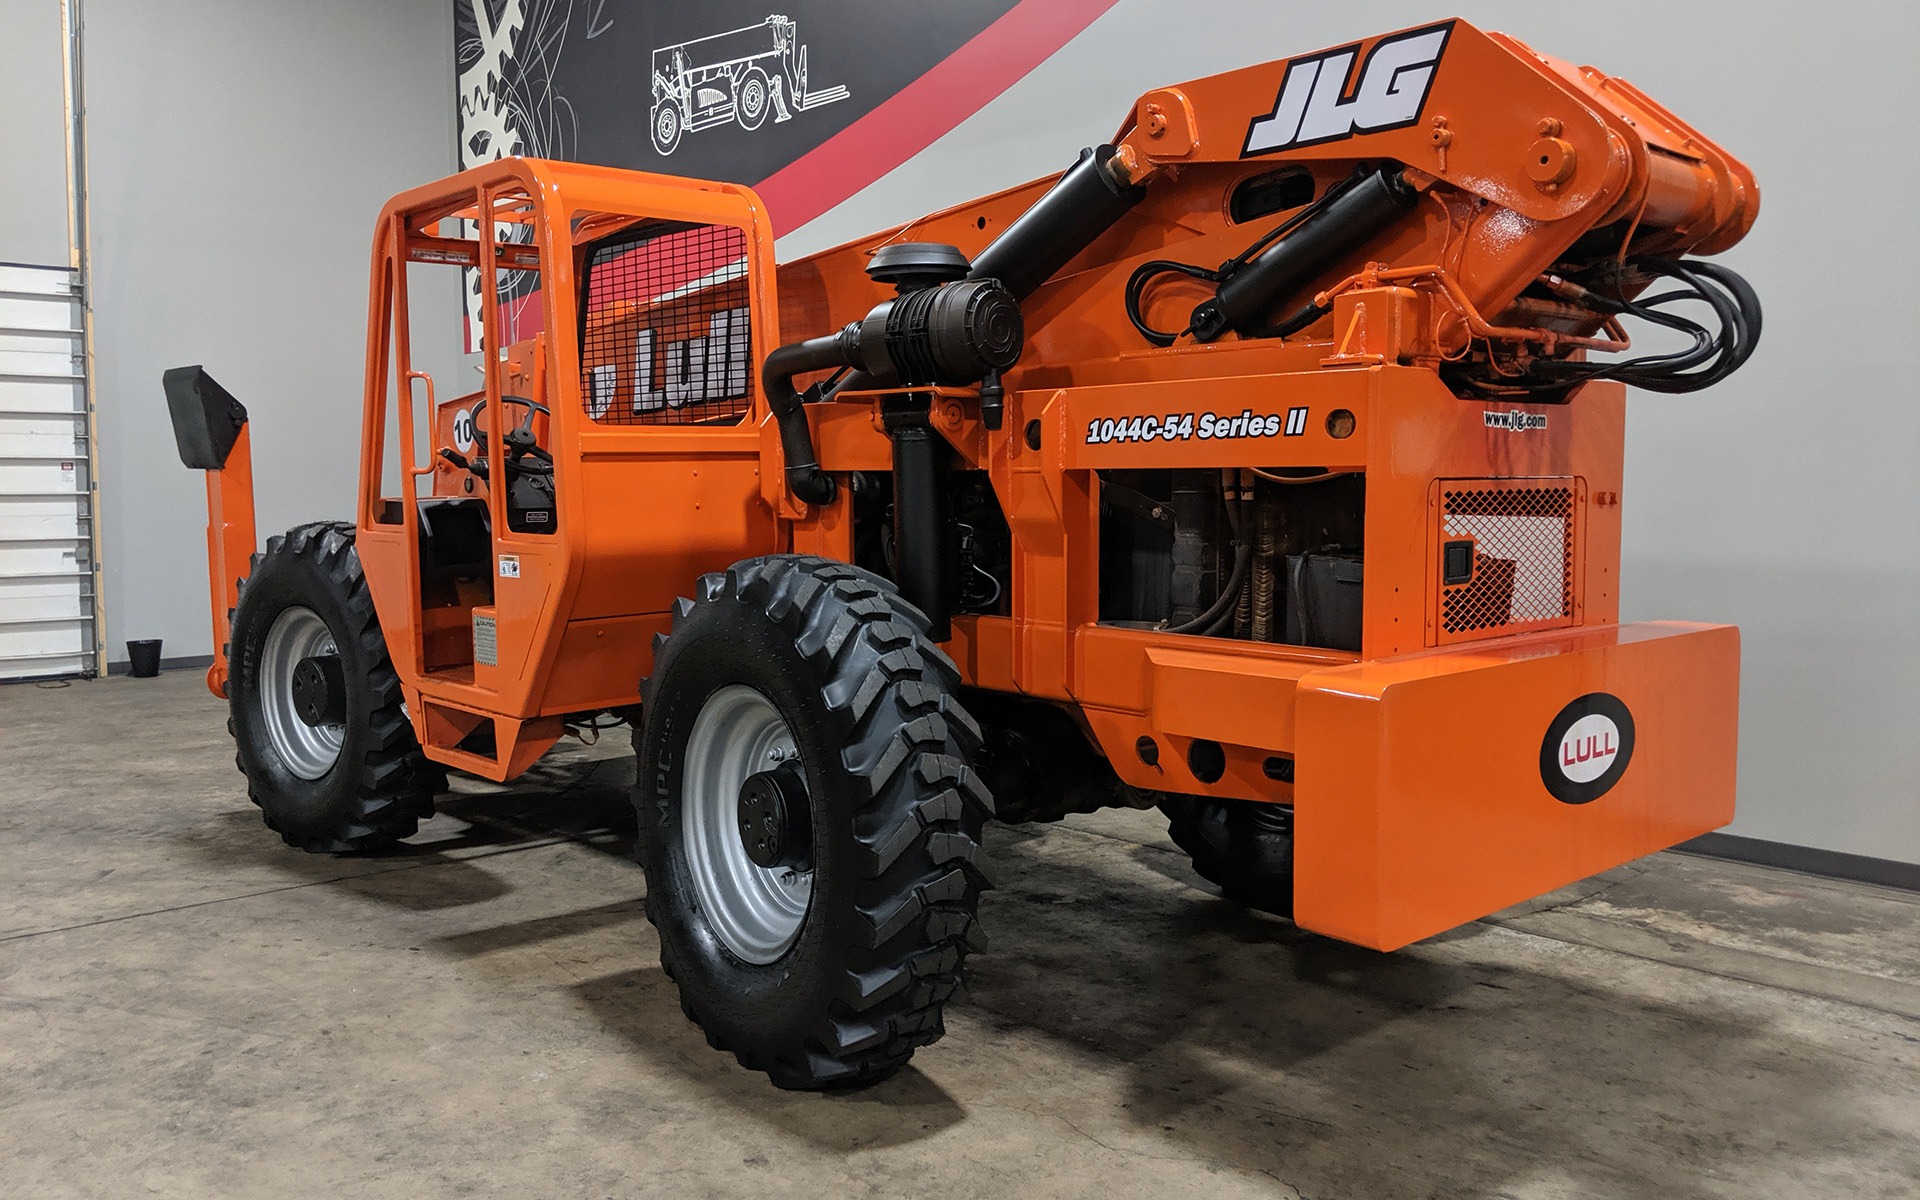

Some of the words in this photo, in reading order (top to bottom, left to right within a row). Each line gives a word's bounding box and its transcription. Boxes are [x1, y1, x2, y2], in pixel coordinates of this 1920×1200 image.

[1242, 24, 1451, 156] JLG
[1086, 413, 1193, 444] 1044C-54
[1197, 409, 1281, 440] Series
[1284, 407, 1308, 436] II
[1484, 410, 1546, 430] www.jlg.com
[1563, 732, 1616, 767] LULL
